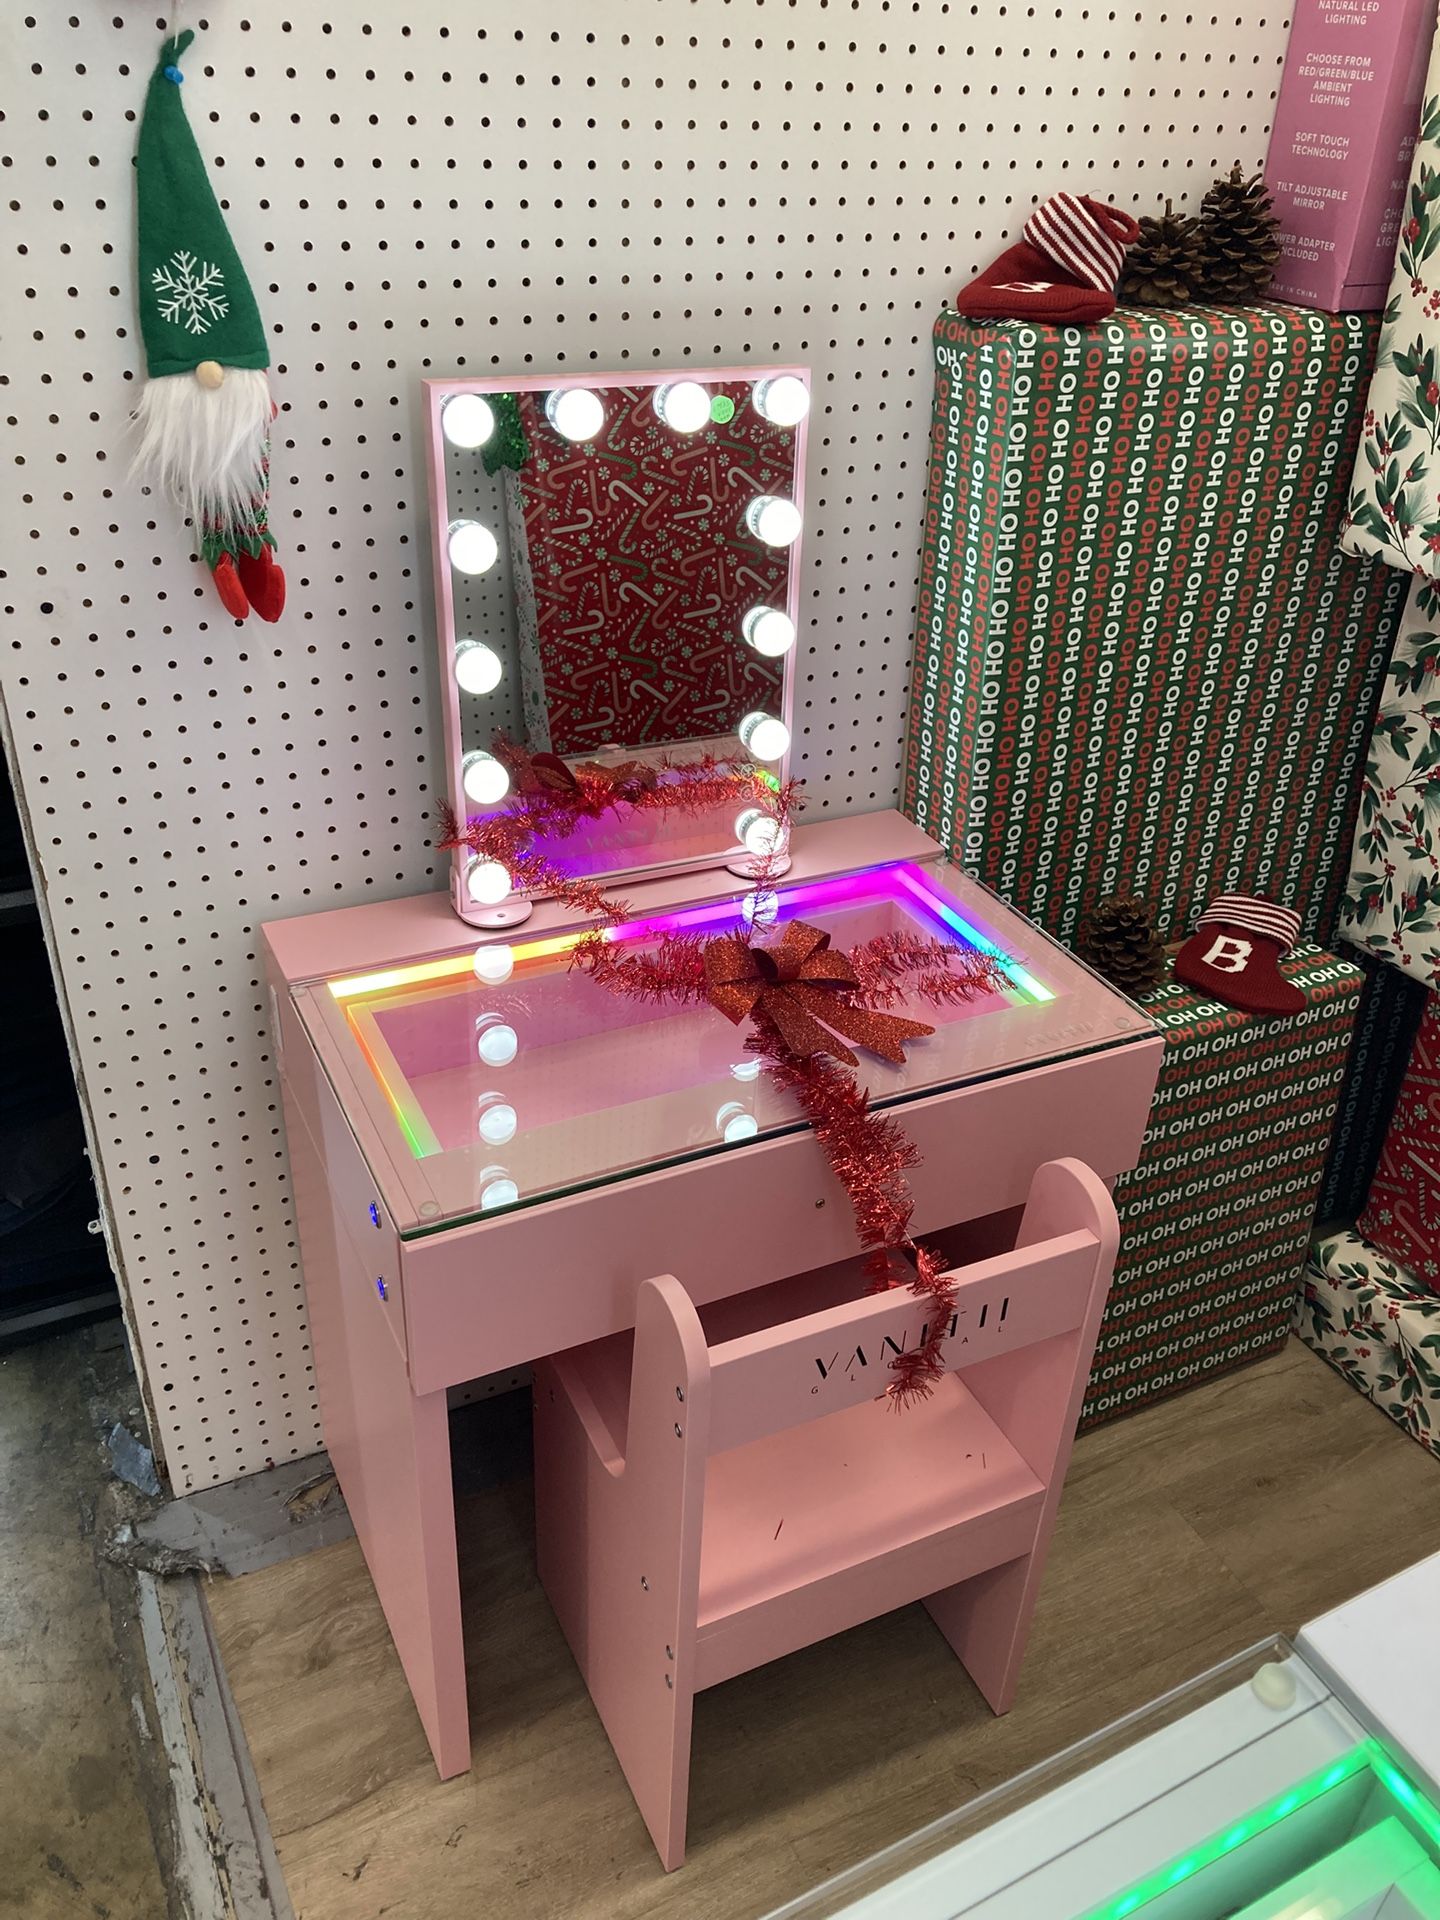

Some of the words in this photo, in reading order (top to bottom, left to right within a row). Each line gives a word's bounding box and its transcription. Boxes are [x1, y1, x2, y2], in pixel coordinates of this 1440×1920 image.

[1318, 0, 1359, 11] NATURAL
[1361, 1, 1380, 12] LED
[1325, 14, 1367, 25] LIGHTING
[1306, 53, 1343, 65] CHOOSE
[1344, 55, 1371, 67] FROM
[1298, 65, 1375, 81] RED/GREEN/BLUE
[1313, 80, 1352, 93] AMBIENT
[1310, 93, 1350, 106] LIGHTING
[1295, 131, 1318, 143] SOFT
[1320, 134, 1350, 147] TOUCH
[1291, 144, 1348, 160] TECHNOLOGY
[1277, 181, 1293, 192] TILT
[1295, 184, 1348, 201] ADJUSTABLE
[1292, 197, 1325, 210] MIRROR
[1298, 236, 1336, 251] ADAPTER
[1281, 246, 1319, 261] NCLUDED
[1296, 289, 1318, 298] CHINA
[1201, 935, 1253, 973] B
